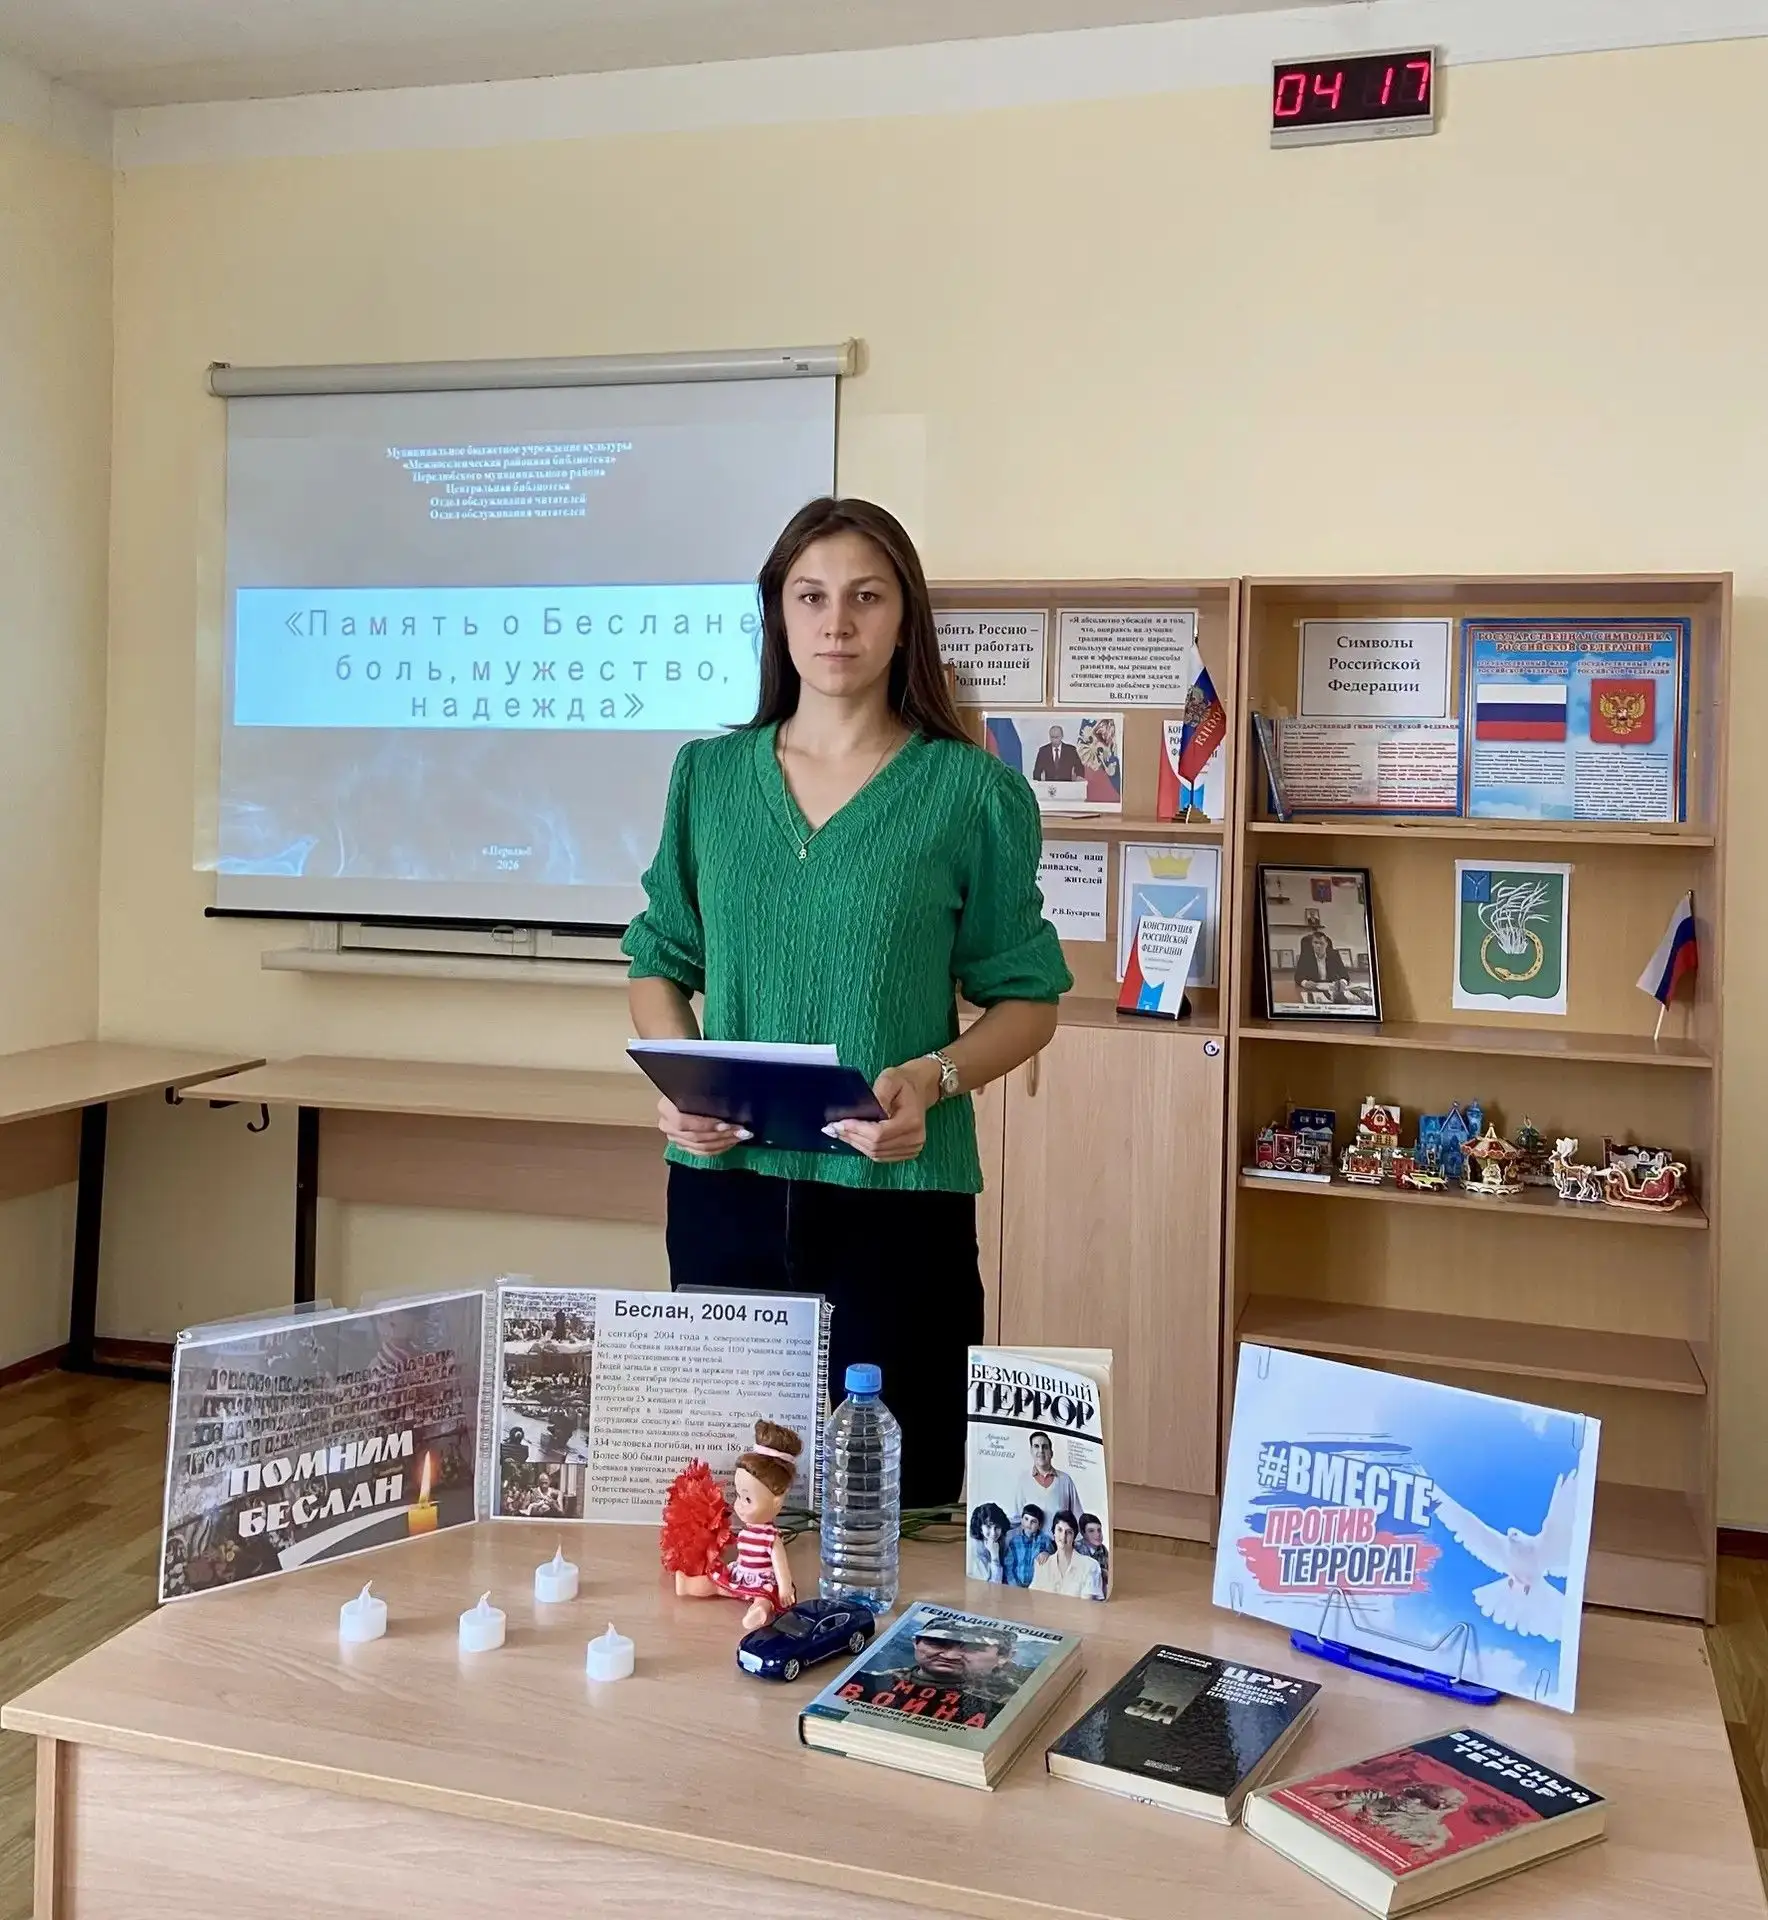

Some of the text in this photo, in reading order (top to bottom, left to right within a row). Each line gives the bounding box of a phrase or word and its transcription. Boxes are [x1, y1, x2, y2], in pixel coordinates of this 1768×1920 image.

[1274, 60, 1430, 116] 04 17
[583, 442, 632, 453] культуры
[446, 481, 571, 496] Центральная библиотека
[430, 494, 586, 509] Отдел обслуживания читателей
[430, 507, 586, 521] Отдел обслуживания читателей
[284, 608, 479, 638] «Память
[503, 614, 519, 636] о
[978, 624, 1028, 635] Россию
[940, 641, 1035, 655] ачит работать
[1336, 635, 1415, 650] Символы
[987, 658, 1031, 669] нашей
[1328, 656, 1422, 671] Российской
[1328, 679, 1421, 695] Федерации
[410, 692, 645, 723] надежда»
[1050, 851, 1078, 860] чтобы
[1064, 876, 1103, 885] жителей
[1142, 920, 1194, 934] КОНСТИТУЦИЯ
[1141, 932, 1189, 945] РОССИЙСКОЙ
[1141, 944, 1184, 956] ФЕДЕРАЦИИ
[614, 1300, 695, 1323] Беслан,
[701, 1303, 748, 1322] 2004
[754, 1309, 789, 1326] год
[607, 1329, 649, 1341] сентября
[653, 1331, 676, 1340] 2004
[971, 1363, 1093, 1403] БЕЗМОЛВНЫЙ
[968, 1380, 1095, 1430] ТЕРРОР
[592, 1450, 620, 1460] Более
[621, 1451, 639, 1460] 800
[229, 1429, 414, 1498] ПОМНИМ
[1257, 1443, 1435, 1529] #ВМЕСТЕ
[238, 1473, 404, 1538] БЕСЛАН
[1262, 1506, 1378, 1548] ПРОТИВ
[1279, 1543, 1419, 1587] ТЕРРОРА!
[920, 1606, 1064, 1642] ГЕННАДИЙ ТРОШЕВ
[1222, 1666, 1303, 1696] ЦРУ:
[892, 1679, 962, 1705] МОЯ
[1449, 1732, 1591, 1804] ВИРУСНЫЙ
[1453, 1744, 1558, 1798] ТЕРРОР
